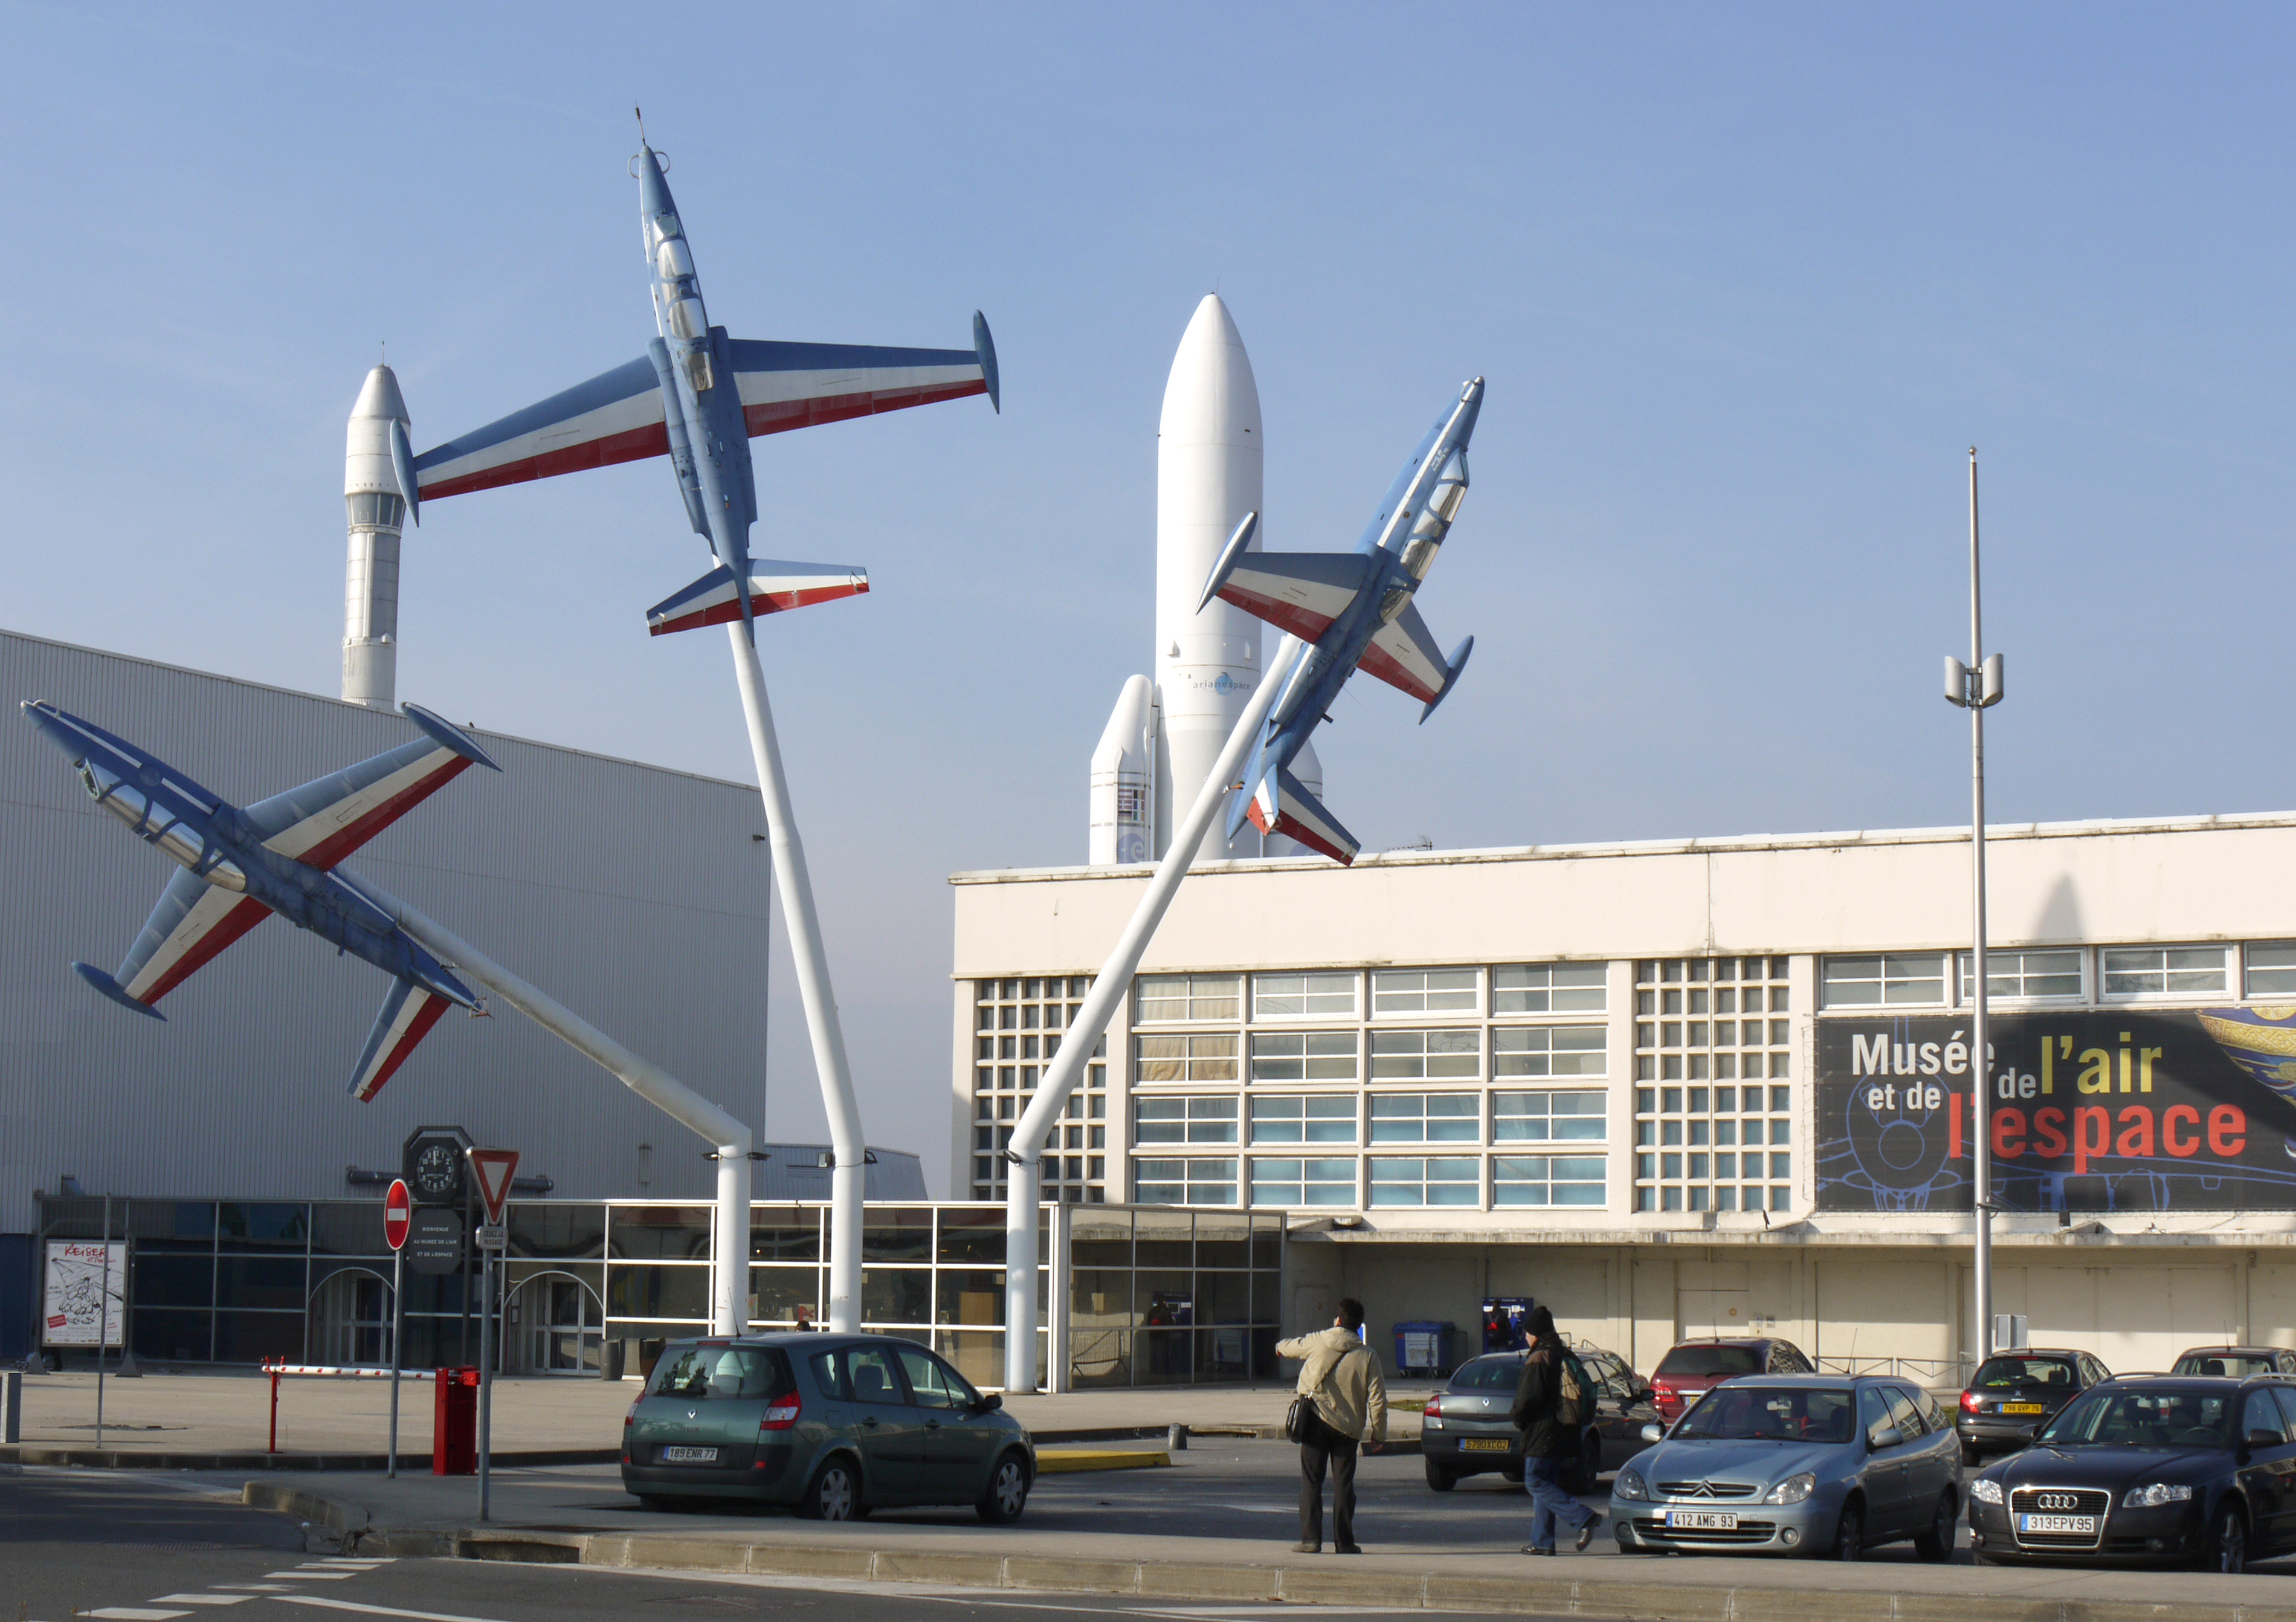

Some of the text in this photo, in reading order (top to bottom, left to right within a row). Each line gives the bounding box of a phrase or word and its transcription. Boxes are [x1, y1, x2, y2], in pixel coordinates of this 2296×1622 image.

[1193, 680, 1251, 690] arianespace
[1998, 1067, 2036, 1099] de
[2041, 1032, 2162, 1094] l'air
[1868, 1082, 2246, 1174] et de lespace
[1674, 1513, 1733, 1527] 412 AMG 93
